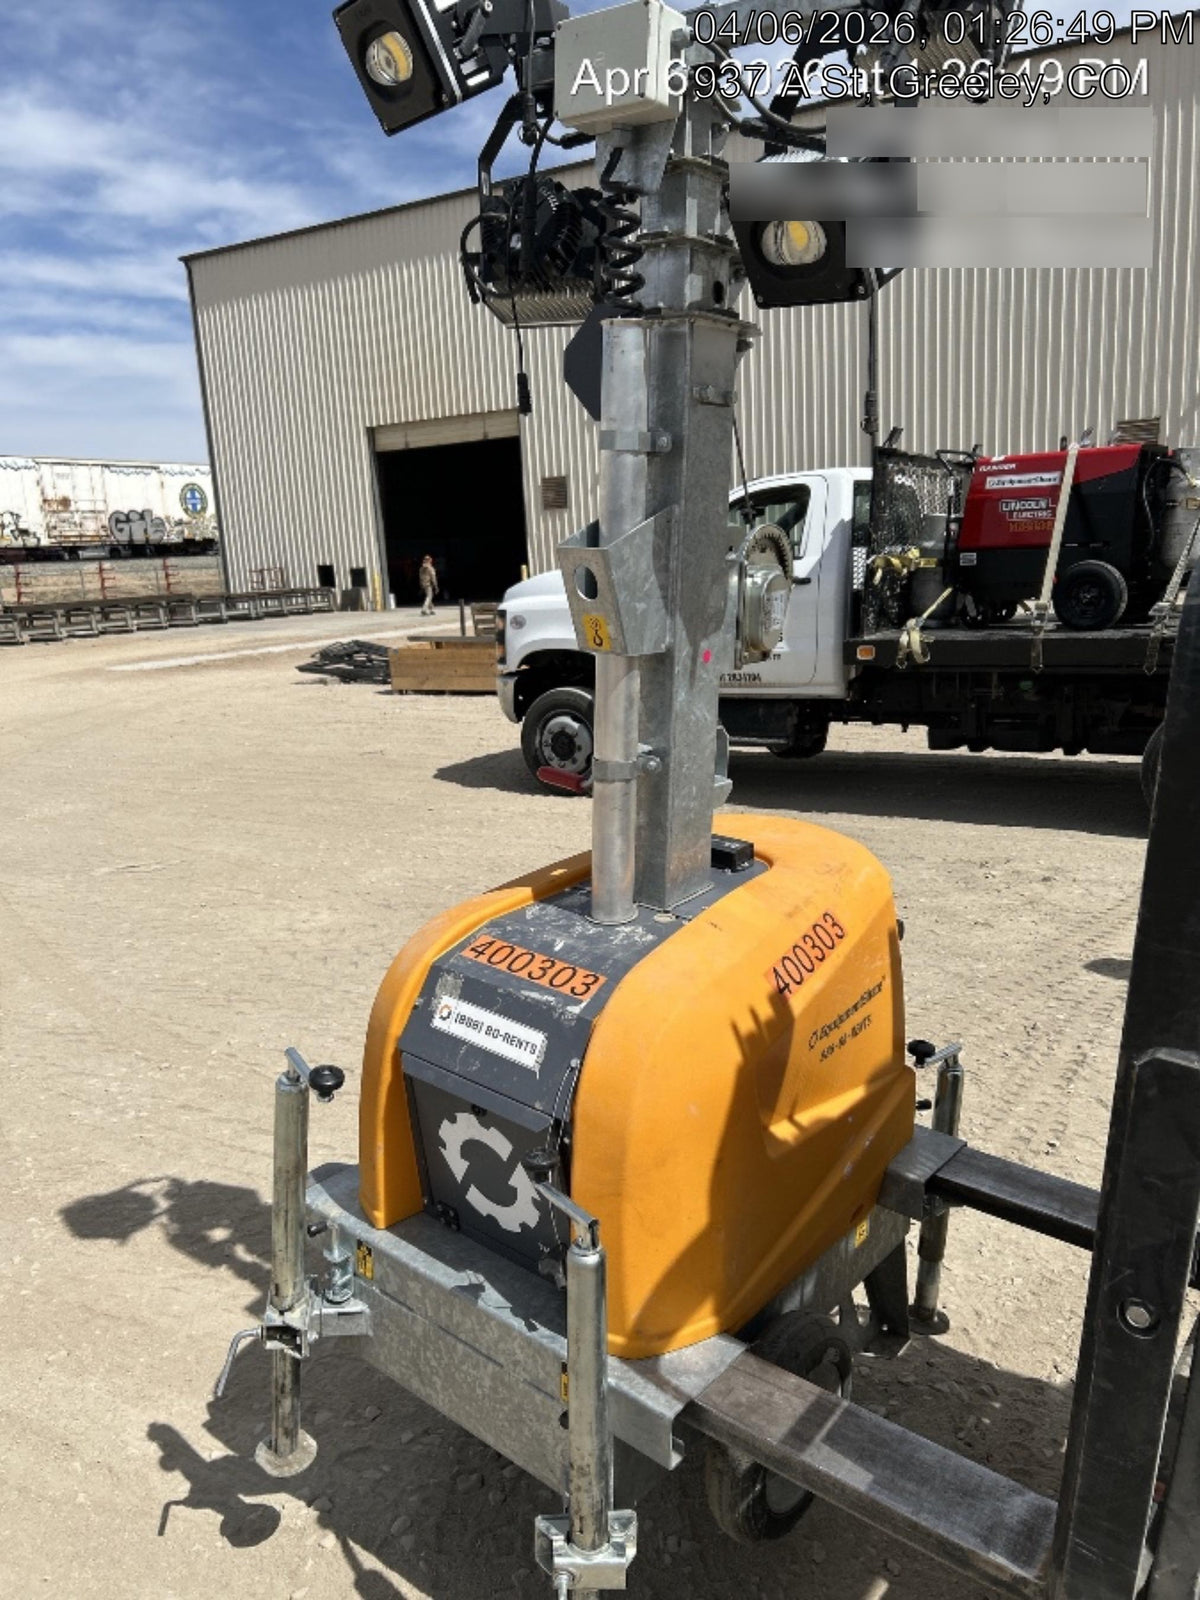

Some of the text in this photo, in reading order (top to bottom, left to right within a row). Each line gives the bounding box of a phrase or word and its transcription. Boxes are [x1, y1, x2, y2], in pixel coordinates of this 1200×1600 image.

[1001, 501, 1048, 512] LINCOLN
[1012, 510, 1053, 519] ELECTRIC
[470, 939, 600, 997] 400303
[772, 911, 846, 995] 400303
